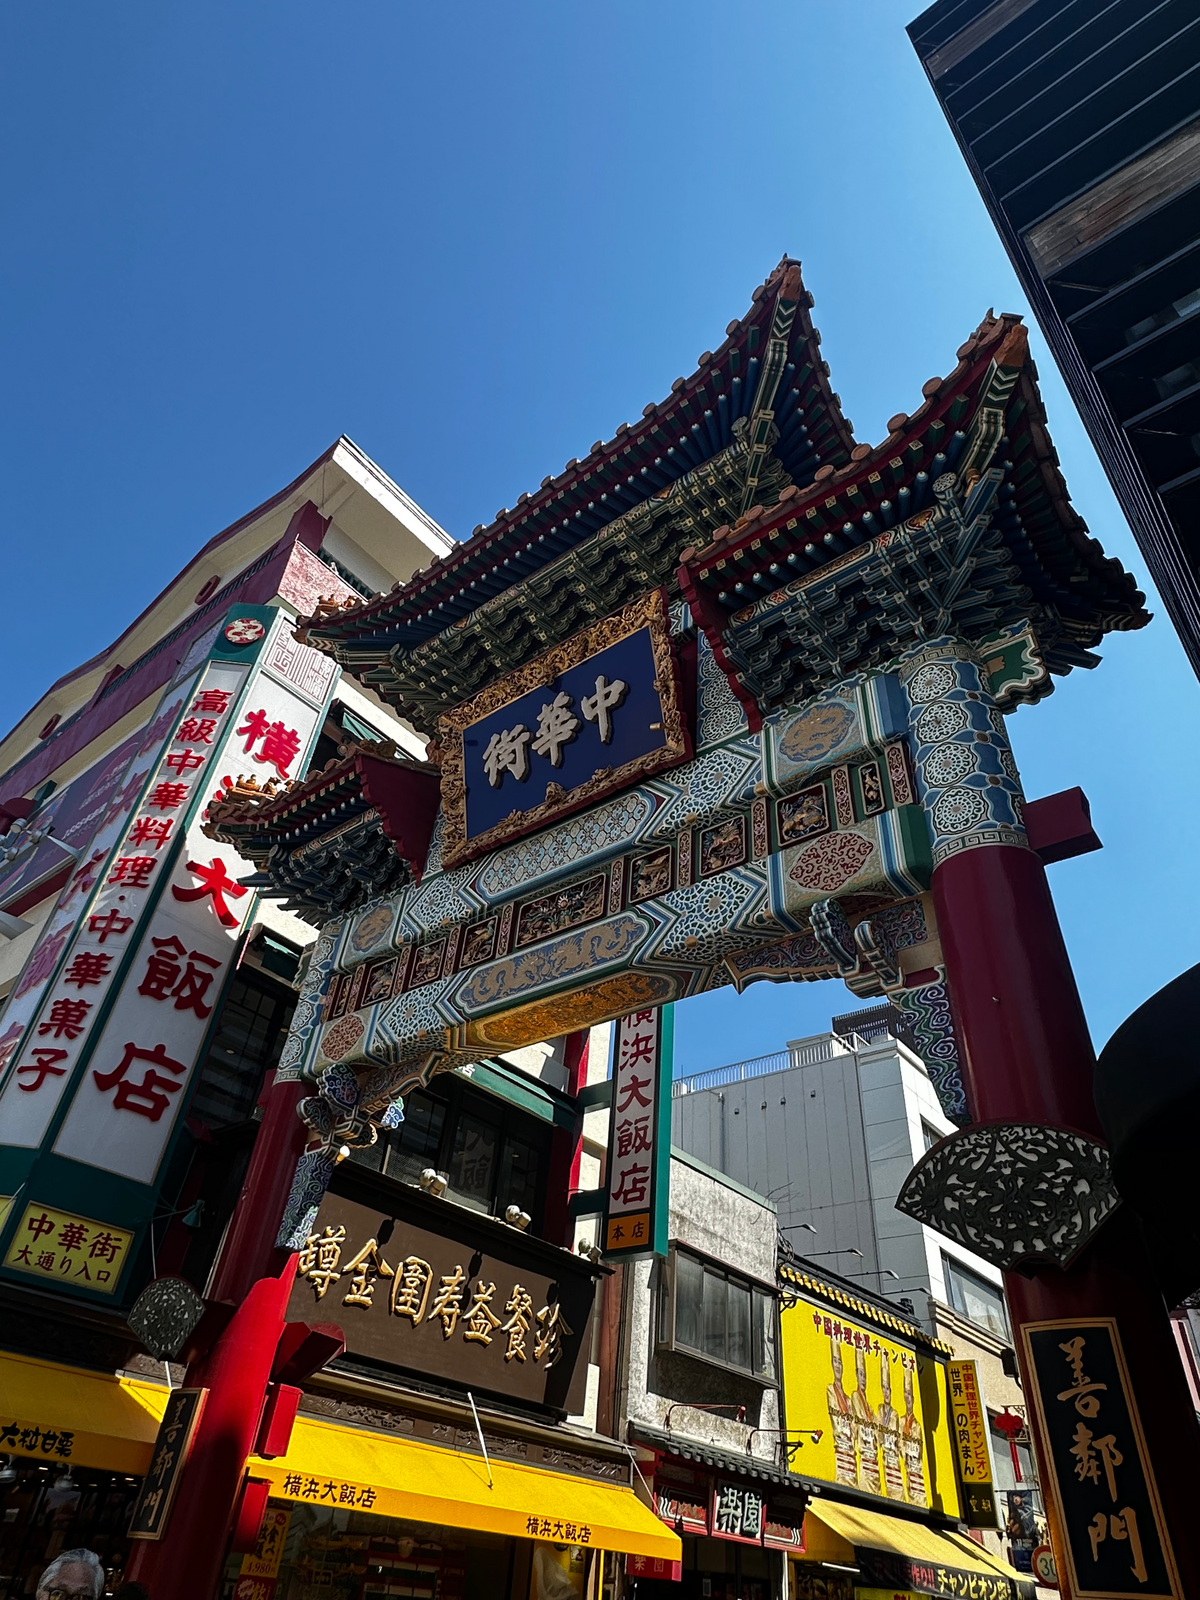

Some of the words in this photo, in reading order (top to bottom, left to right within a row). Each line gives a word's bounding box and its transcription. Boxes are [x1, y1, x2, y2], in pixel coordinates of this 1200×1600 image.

[483, 675, 628, 787] 中華街
[93, 708, 301, 1122] 横大飯店
[27, 1213, 123, 1264] 中華街
[611, 1221, 645, 1242] 本店
[13, 1244, 113, 1284] 大通り入口
[950, 1367, 975, 1476] 世界一の肉まん
[961, 1363, 988, 1481] 中国料理世界チャンピオン
[283, 1472, 377, 1510] 横浜大飯店
[526, 1516, 592, 1544] 横浜大飯店
